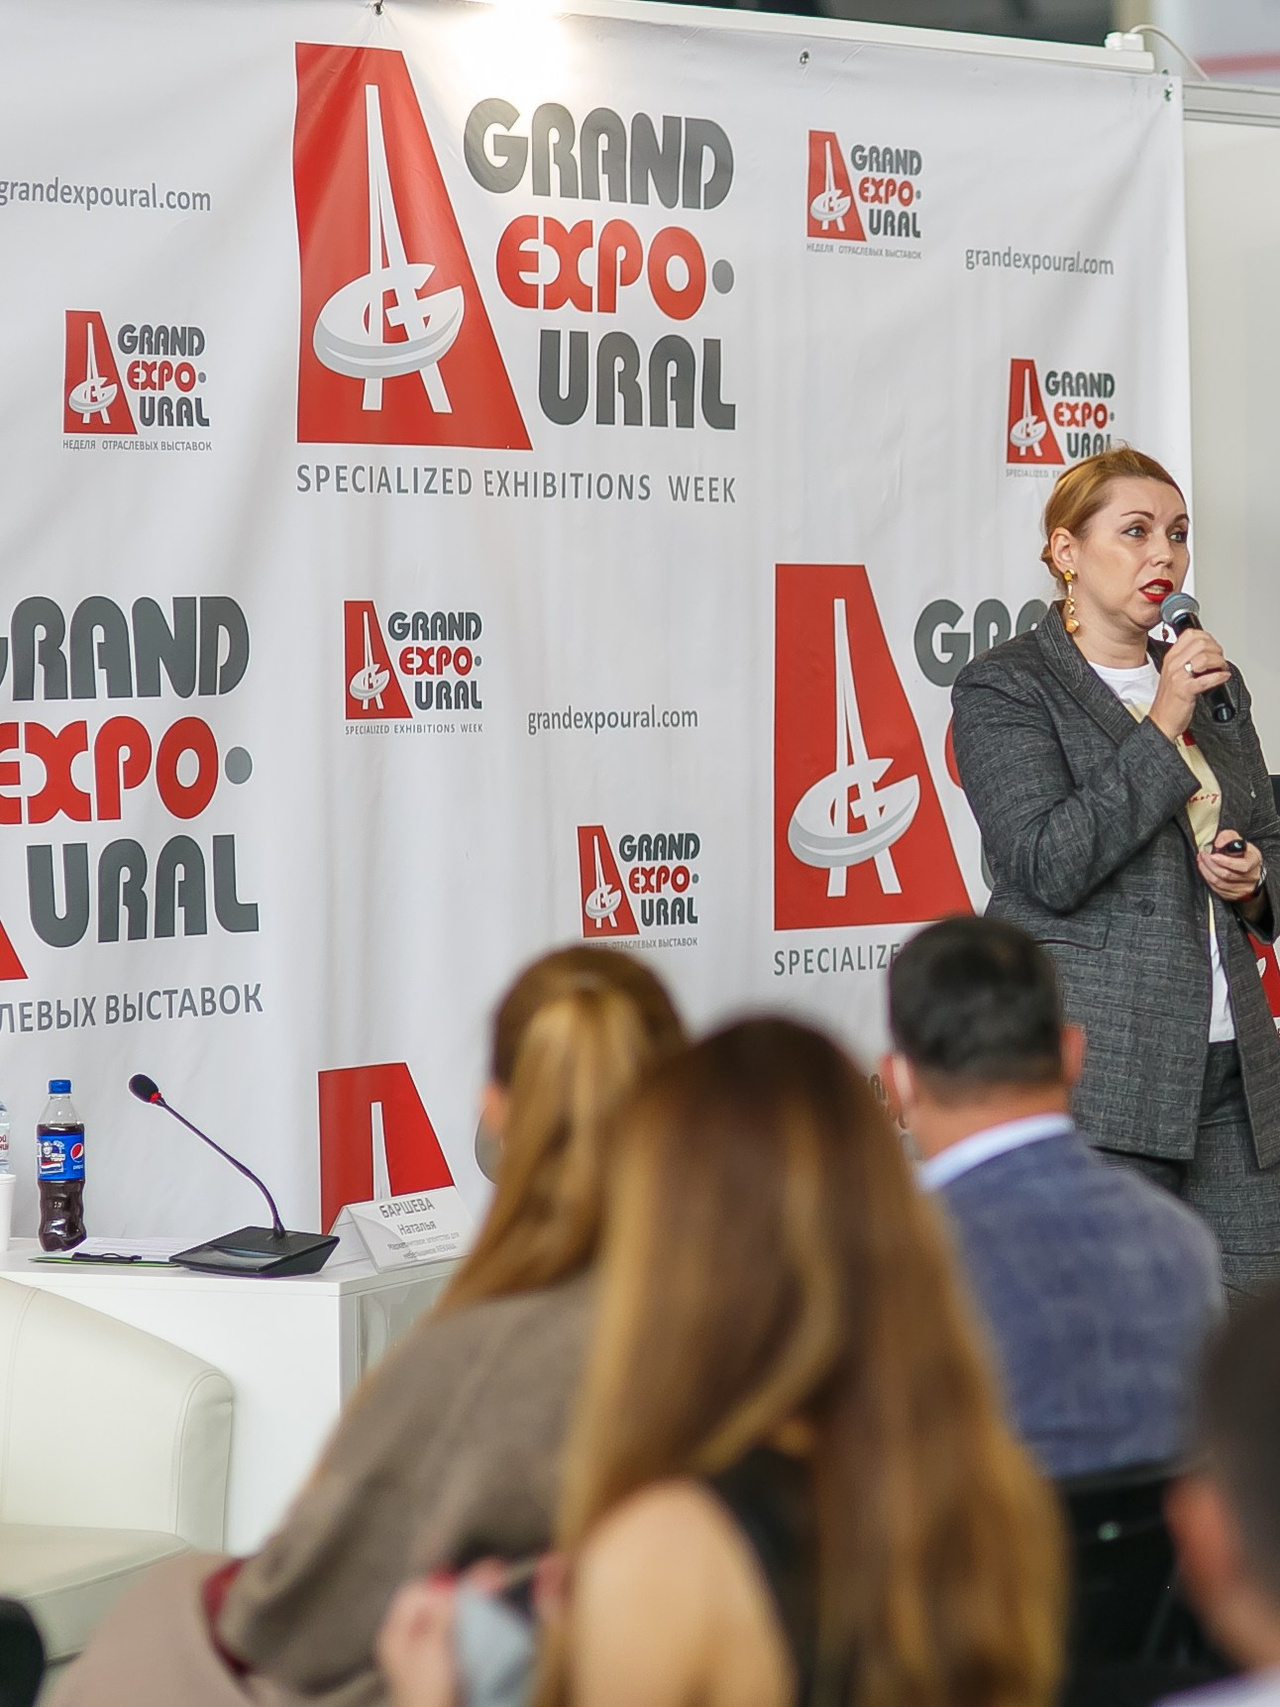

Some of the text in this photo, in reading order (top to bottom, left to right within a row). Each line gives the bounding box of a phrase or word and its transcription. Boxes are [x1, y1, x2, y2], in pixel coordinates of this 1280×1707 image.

[464, 98, 733, 210] GRAND
[851, 145, 922, 176] GRAND
[869, 209, 921, 238] URAL
[966, 246, 1114, 275] grandexpoural.com
[117, 324, 205, 356] GRAND
[539, 329, 736, 430] URAL
[1045, 370, 1115, 398] GRAND
[139, 396, 210, 427] URAL
[63, 440, 212, 451] НЕДЕЛЯ ОТРАСЛЕВЫХ ВЫСТАВОК
[297, 464, 736, 503] SPECIALIZED EXHIBITIONS WEEK
[388, 611, 482, 641] GRAND
[0, 596, 249, 701] RAND
[415, 681, 482, 710] URAL
[346, 723, 483, 735] SPECIALIZED EXHIBITIONS WEEK
[528, 704, 698, 735] grandexpoural.com
[619, 833, 700, 862] GRAND
[26, 834, 259, 948] URAL
[641, 897, 698, 927] URAL
[658, 937, 698, 948] ВЫСТАВОК
[106, 983, 263, 1025] ВЫСТАВОК
[379, 1198, 435, 1218] БАРШЕВА
[397, 1221, 436, 1235] Наталья
